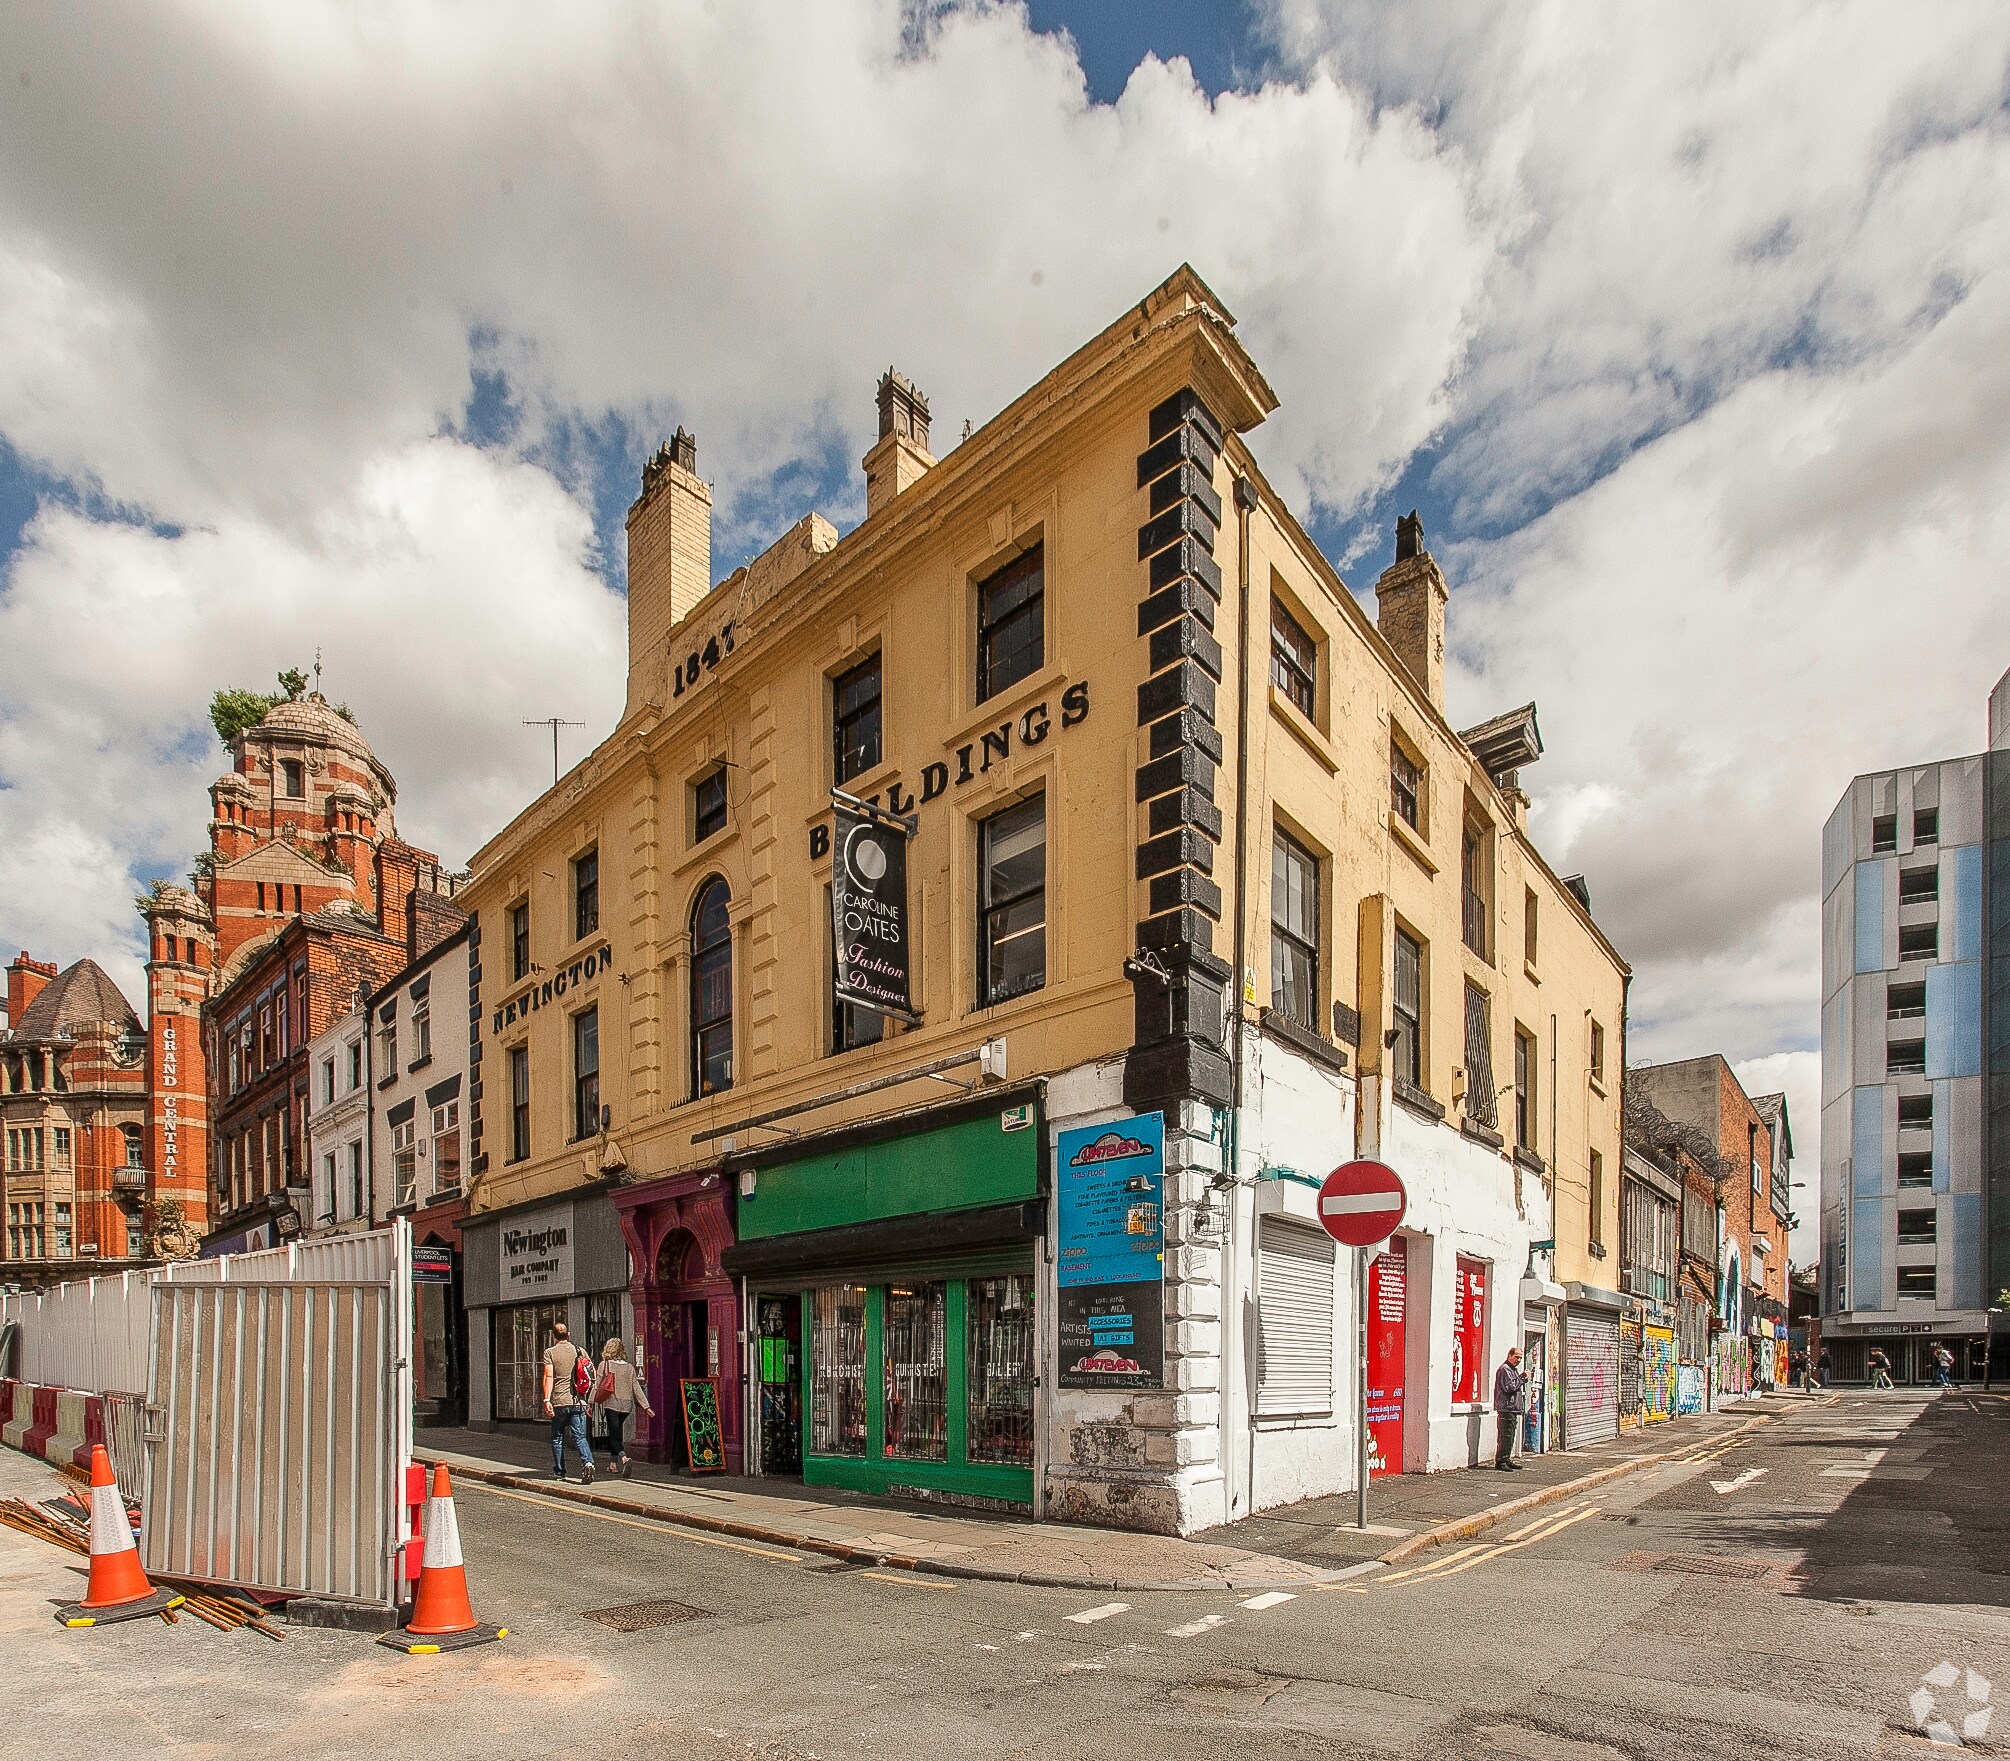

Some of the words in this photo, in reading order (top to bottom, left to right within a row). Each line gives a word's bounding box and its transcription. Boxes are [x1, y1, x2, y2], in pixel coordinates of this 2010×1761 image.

[673, 618, 737, 699] 1847
[809, 681, 1090, 860] BILDINGS
[843, 893, 900, 920] CAROLINE
[845, 912, 900, 943] OATES
[845, 943, 905, 979] Fashion
[492, 943, 613, 1036] NEWINGTON
[848, 970, 906, 1003] Designer
[163, 1029, 178, 1087] GRAND
[164, 1096, 179, 1178] CENTRAL
[1071, 1171, 1085, 1179] THIS
[1086, 1183, 1106, 1191] SWEETS
[1075, 1200, 1101, 1208] CIGARETTE
[1124, 1194, 1146, 1202] FILTERS
[1078, 1192, 1089, 1200] FINE
[1086, 1220, 1100, 1228] PIPES
[503, 1226, 568, 1257] Newington
[1130, 1239, 1162, 1252] zippo
[1061, 1246, 1088, 1258] zippo
[526, 1258, 559, 1273] COMPANY
[1060, 1263, 1092, 1272] BASEMENT
[1090, 1317, 1131, 1326] ACCESSORIES
[1868, 1325, 1899, 1334] secure
[1061, 1338, 1091, 1347] WANTED
